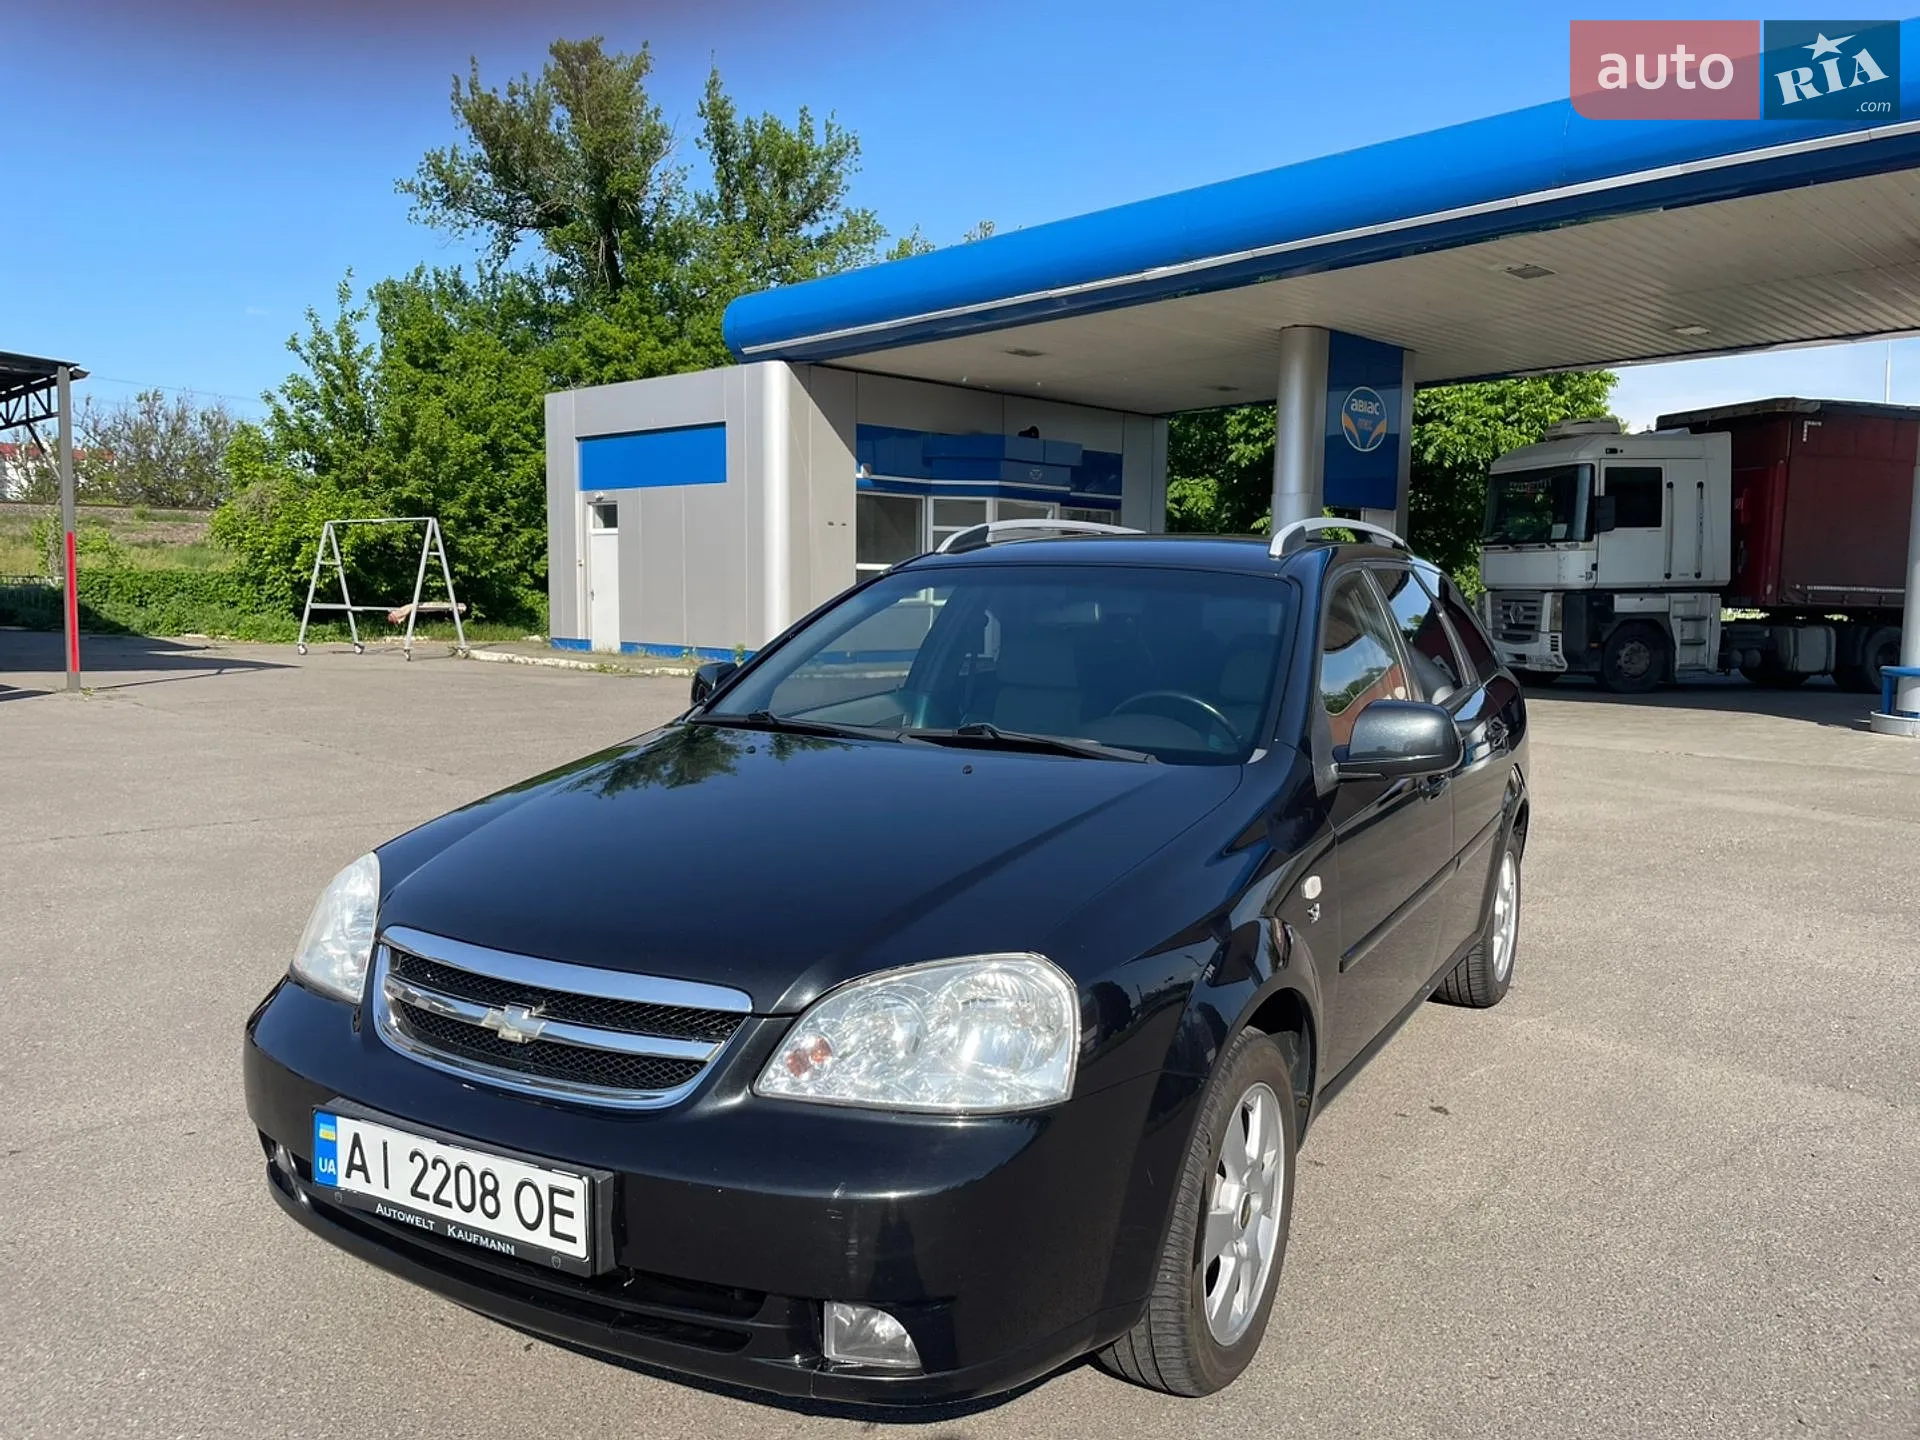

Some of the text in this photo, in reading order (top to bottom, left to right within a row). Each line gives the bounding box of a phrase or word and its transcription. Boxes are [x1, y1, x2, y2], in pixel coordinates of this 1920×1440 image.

[318, 1159, 336, 1175] UA
[344, 1131, 578, 1244] AI 2208 OE
